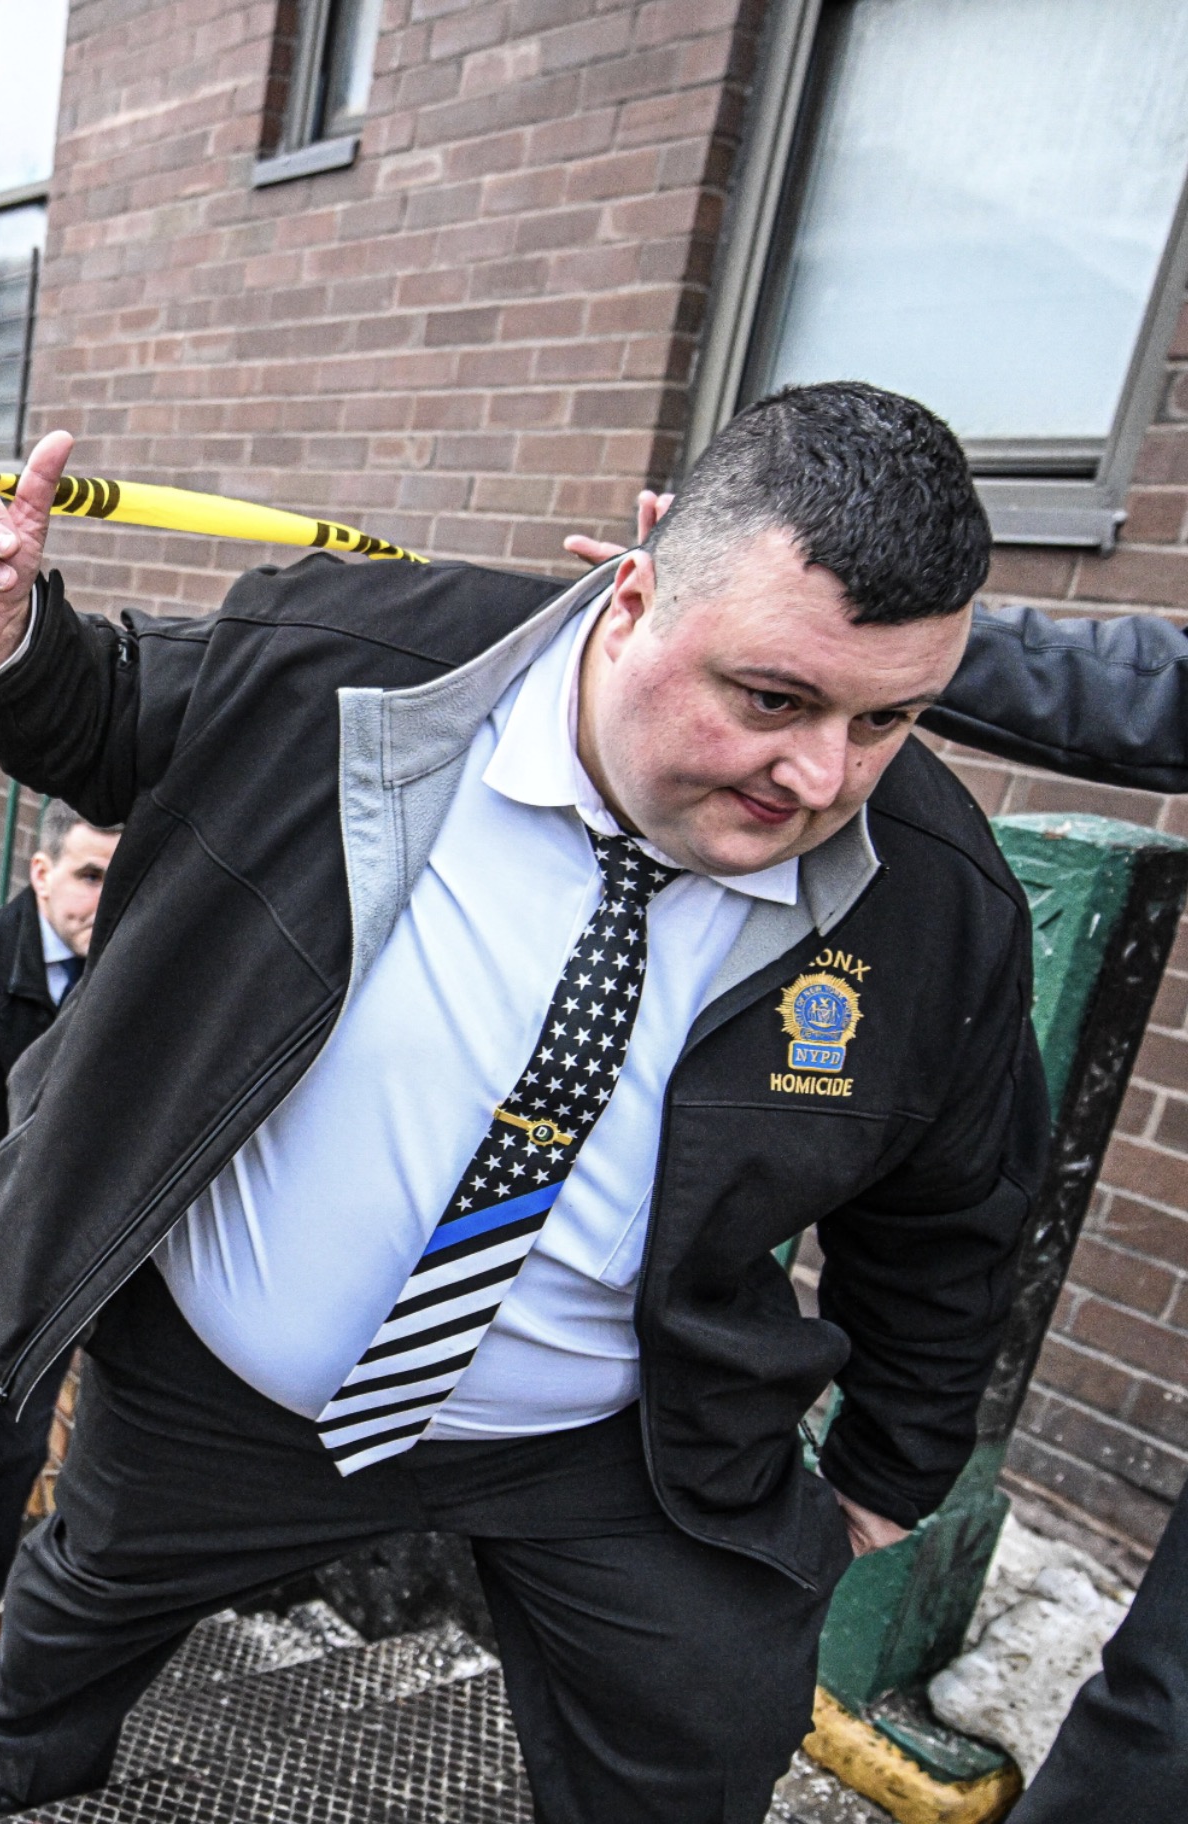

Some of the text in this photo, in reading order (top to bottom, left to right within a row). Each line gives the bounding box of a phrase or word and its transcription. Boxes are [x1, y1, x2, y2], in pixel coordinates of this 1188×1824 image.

[808, 948, 871, 982] ONX
[795, 1048, 842, 1066] NYPD
[770, 1073, 854, 1097] HOMICIDE
